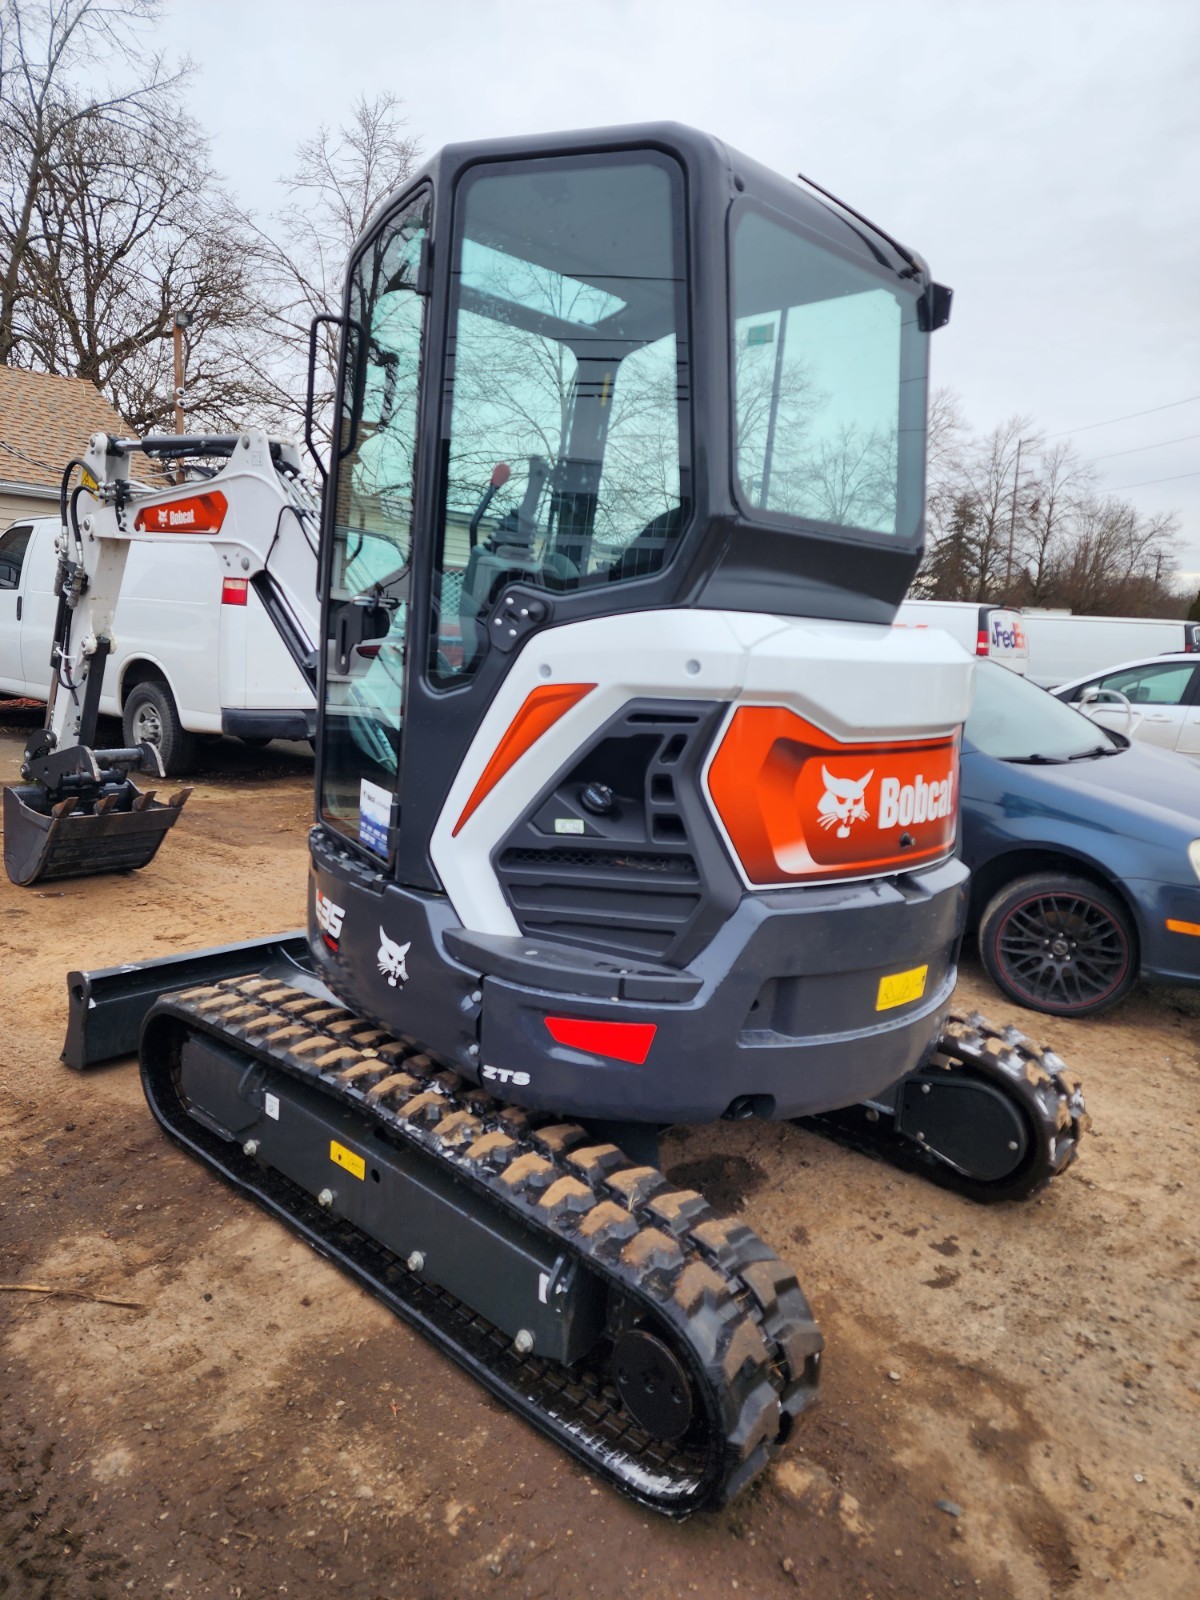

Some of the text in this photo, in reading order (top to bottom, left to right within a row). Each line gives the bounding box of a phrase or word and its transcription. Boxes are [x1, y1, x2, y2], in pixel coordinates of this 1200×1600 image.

[169, 508, 195, 525] Bobcat
[878, 770, 953, 829] Bobcat
[482, 1064, 531, 1086] ZTS
